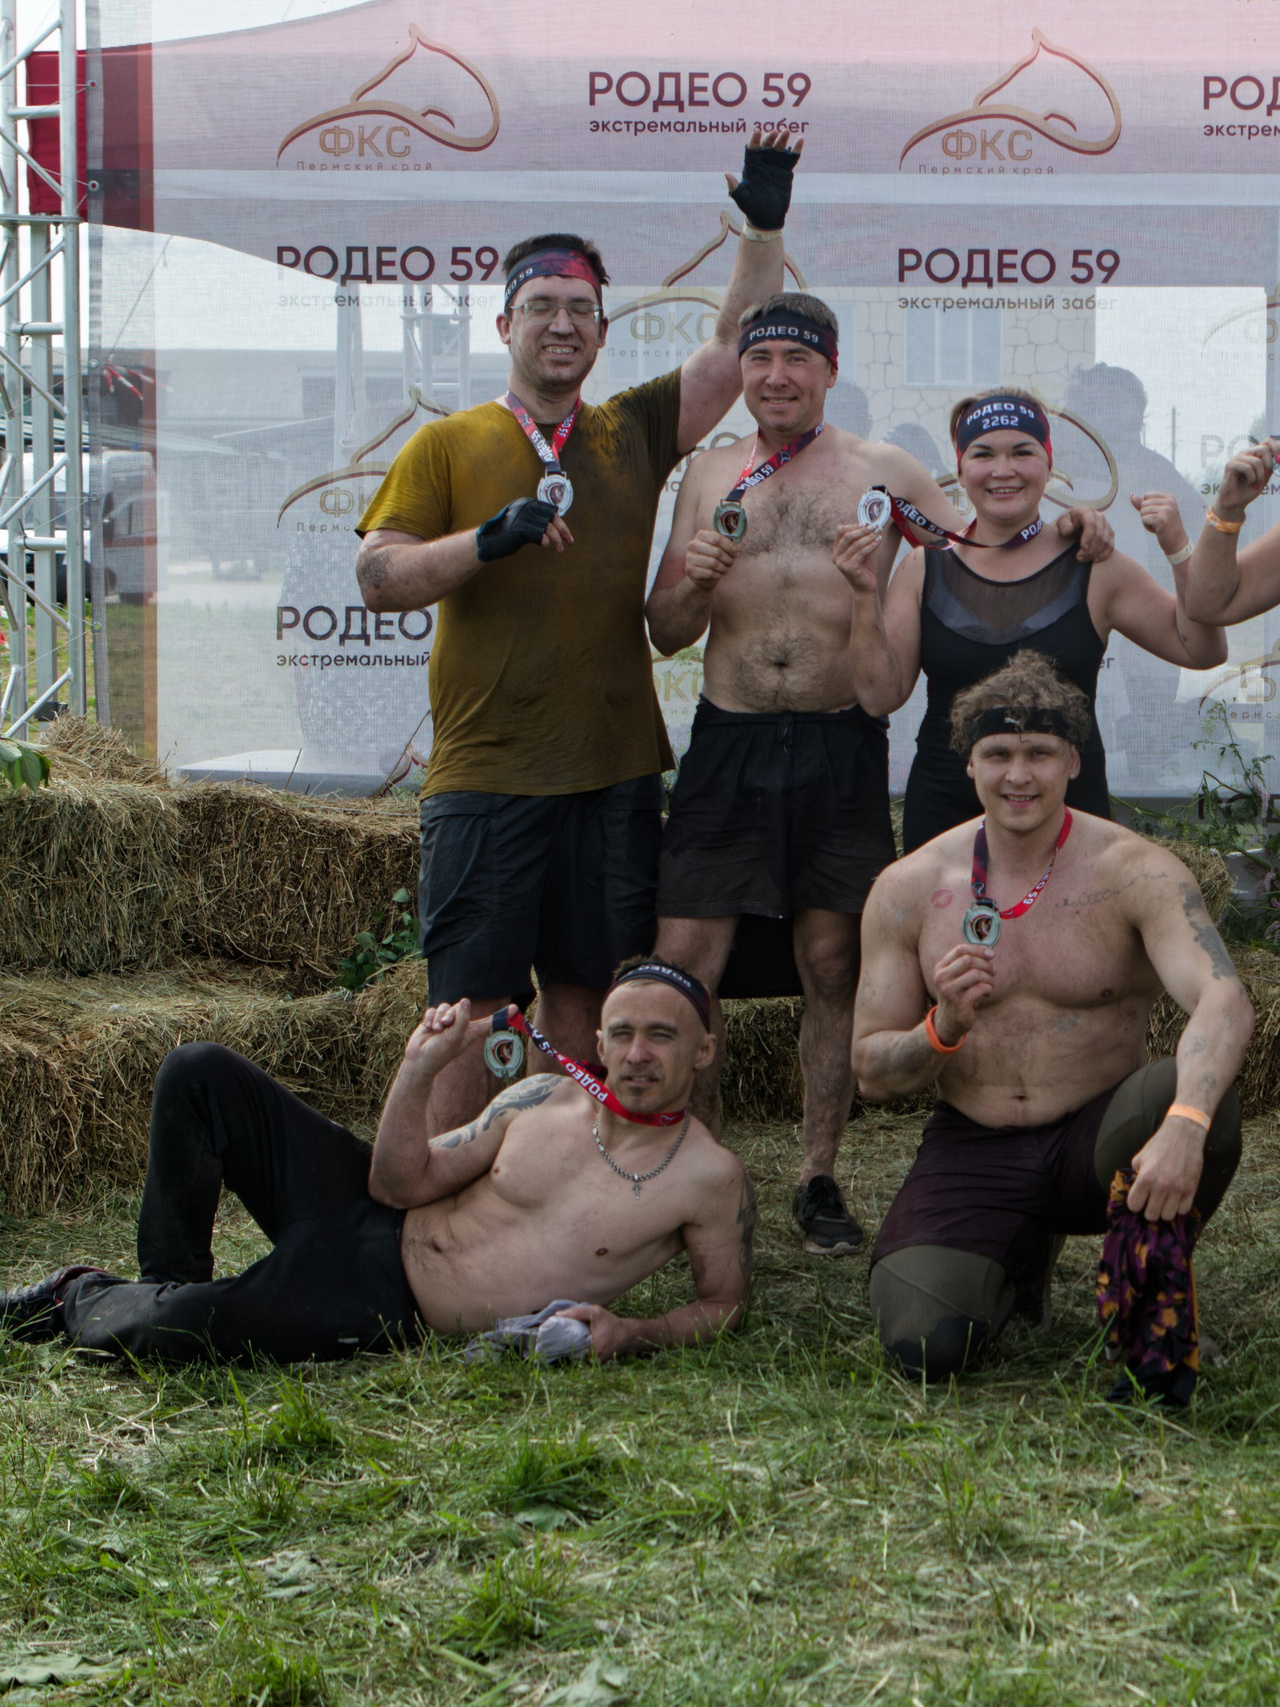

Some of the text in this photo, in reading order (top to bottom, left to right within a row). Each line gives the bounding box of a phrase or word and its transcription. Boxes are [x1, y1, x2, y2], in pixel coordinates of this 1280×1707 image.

[589, 71, 812, 113] РОДЕО 59
[589, 119, 746, 136] экстремальный
[319, 125, 412, 158] ФКС
[941, 129, 1033, 161] ФКС
[296, 161, 433, 172] Пермский край
[919, 164, 1054, 176] Пермский край
[276, 245, 499, 287] РОДЕО 59
[898, 248, 1120, 289] РОДЕО 59
[898, 294, 1117, 312] экстремальный забег
[750, 326, 819, 343] РОДЕО 59
[966, 402, 1035, 425] РОДЕО 59
[982, 415, 1019, 430] 2262
[276, 605, 433, 647] РОДЕО
[276, 652, 430, 670] экстремальный
[565, 1062, 609, 1103] РОДЕО
